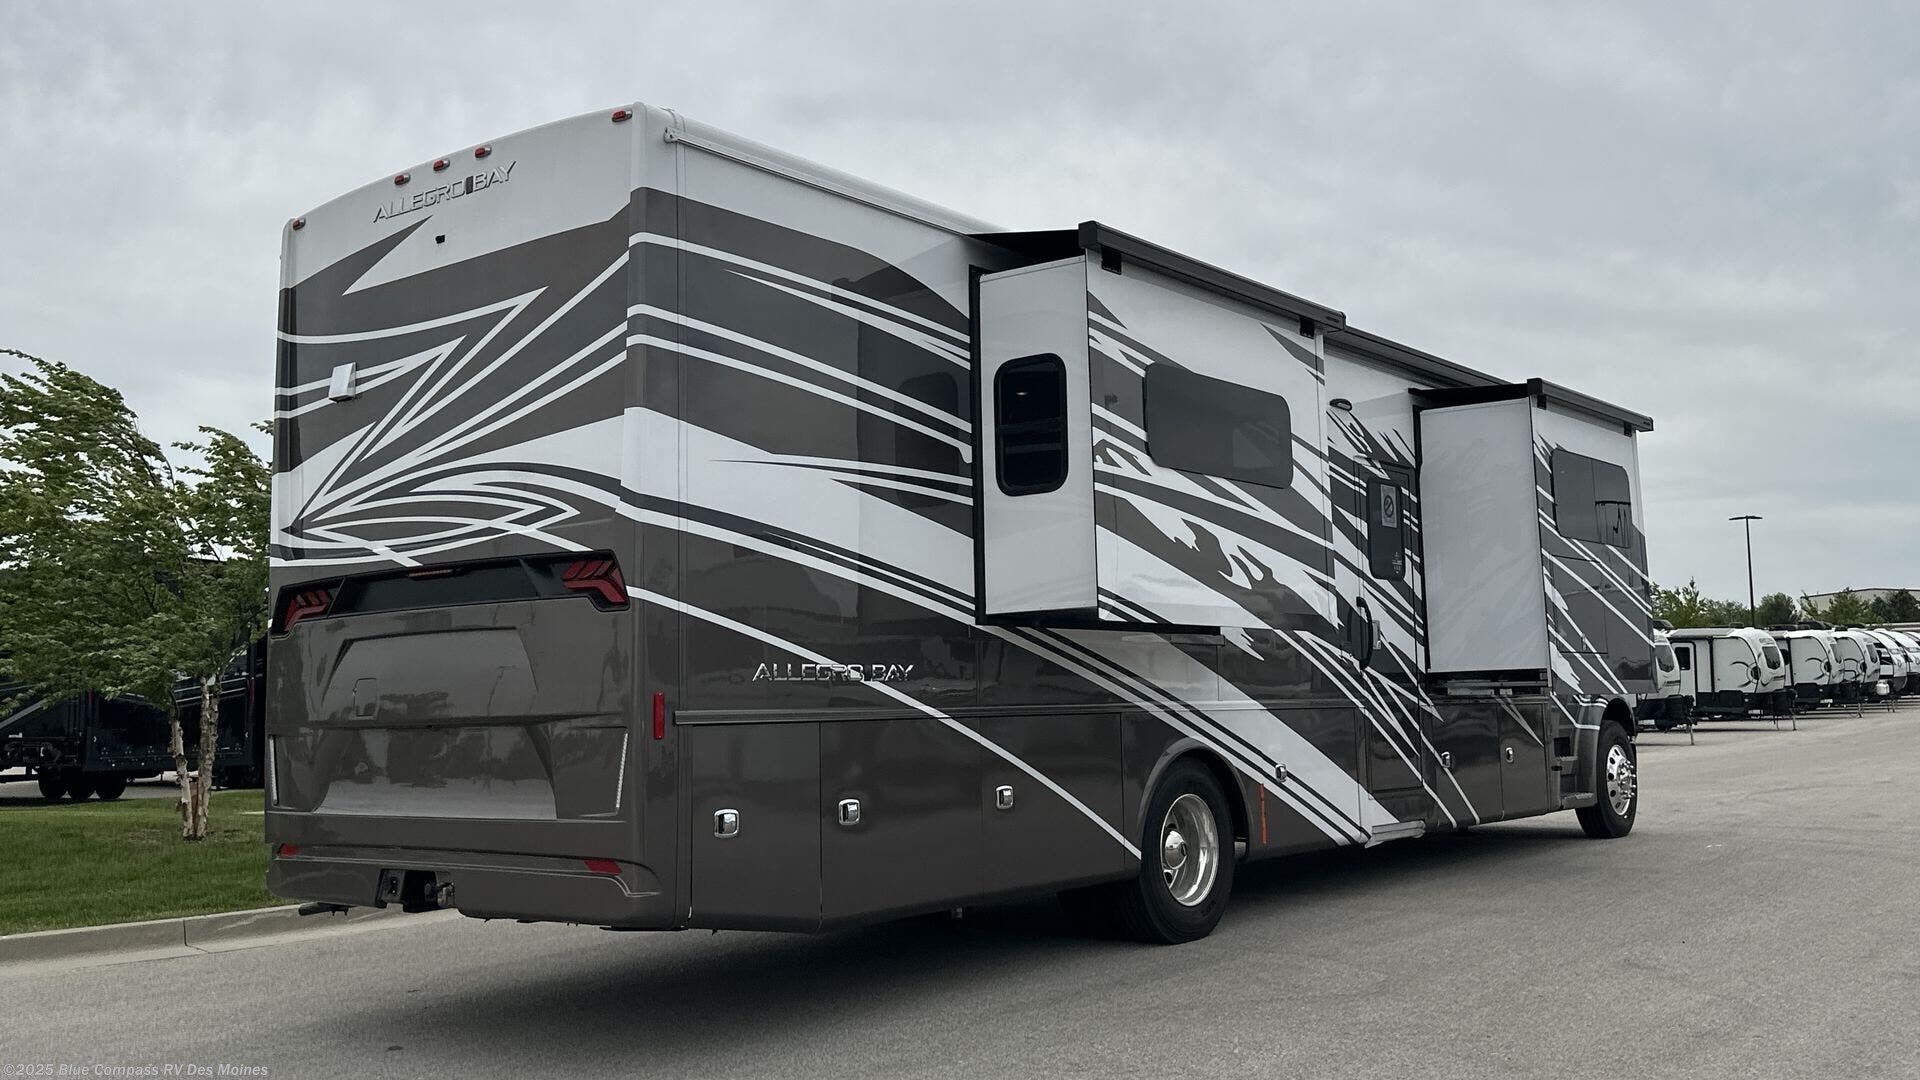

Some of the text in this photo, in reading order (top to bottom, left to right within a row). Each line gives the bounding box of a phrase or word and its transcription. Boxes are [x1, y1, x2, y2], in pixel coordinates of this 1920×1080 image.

[373, 161, 517, 223] ALLEGRO BAY
[752, 662, 914, 682] ALLEGRO BAY
